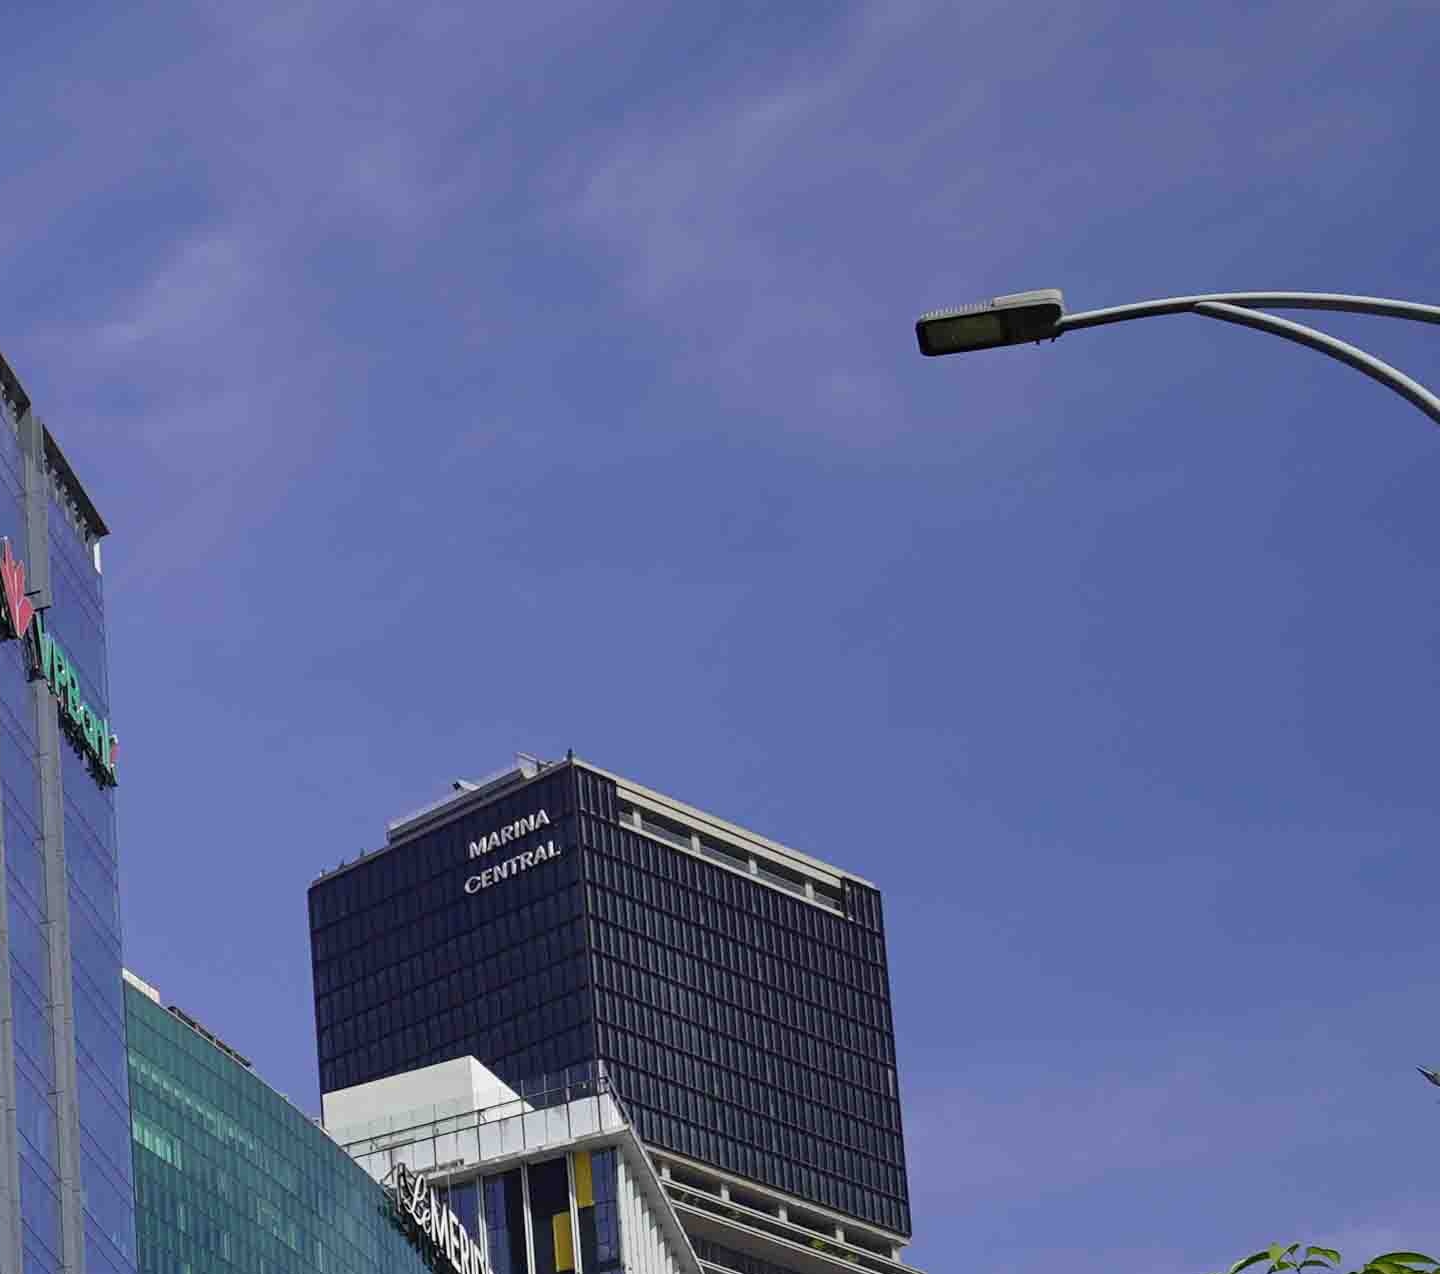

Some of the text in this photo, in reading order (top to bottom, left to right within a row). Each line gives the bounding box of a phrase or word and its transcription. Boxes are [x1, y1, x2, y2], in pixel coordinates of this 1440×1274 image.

[35, 613, 121, 787] VPBank
[469, 808, 550, 859] MARINA
[464, 840, 561, 894] CENTRAL
